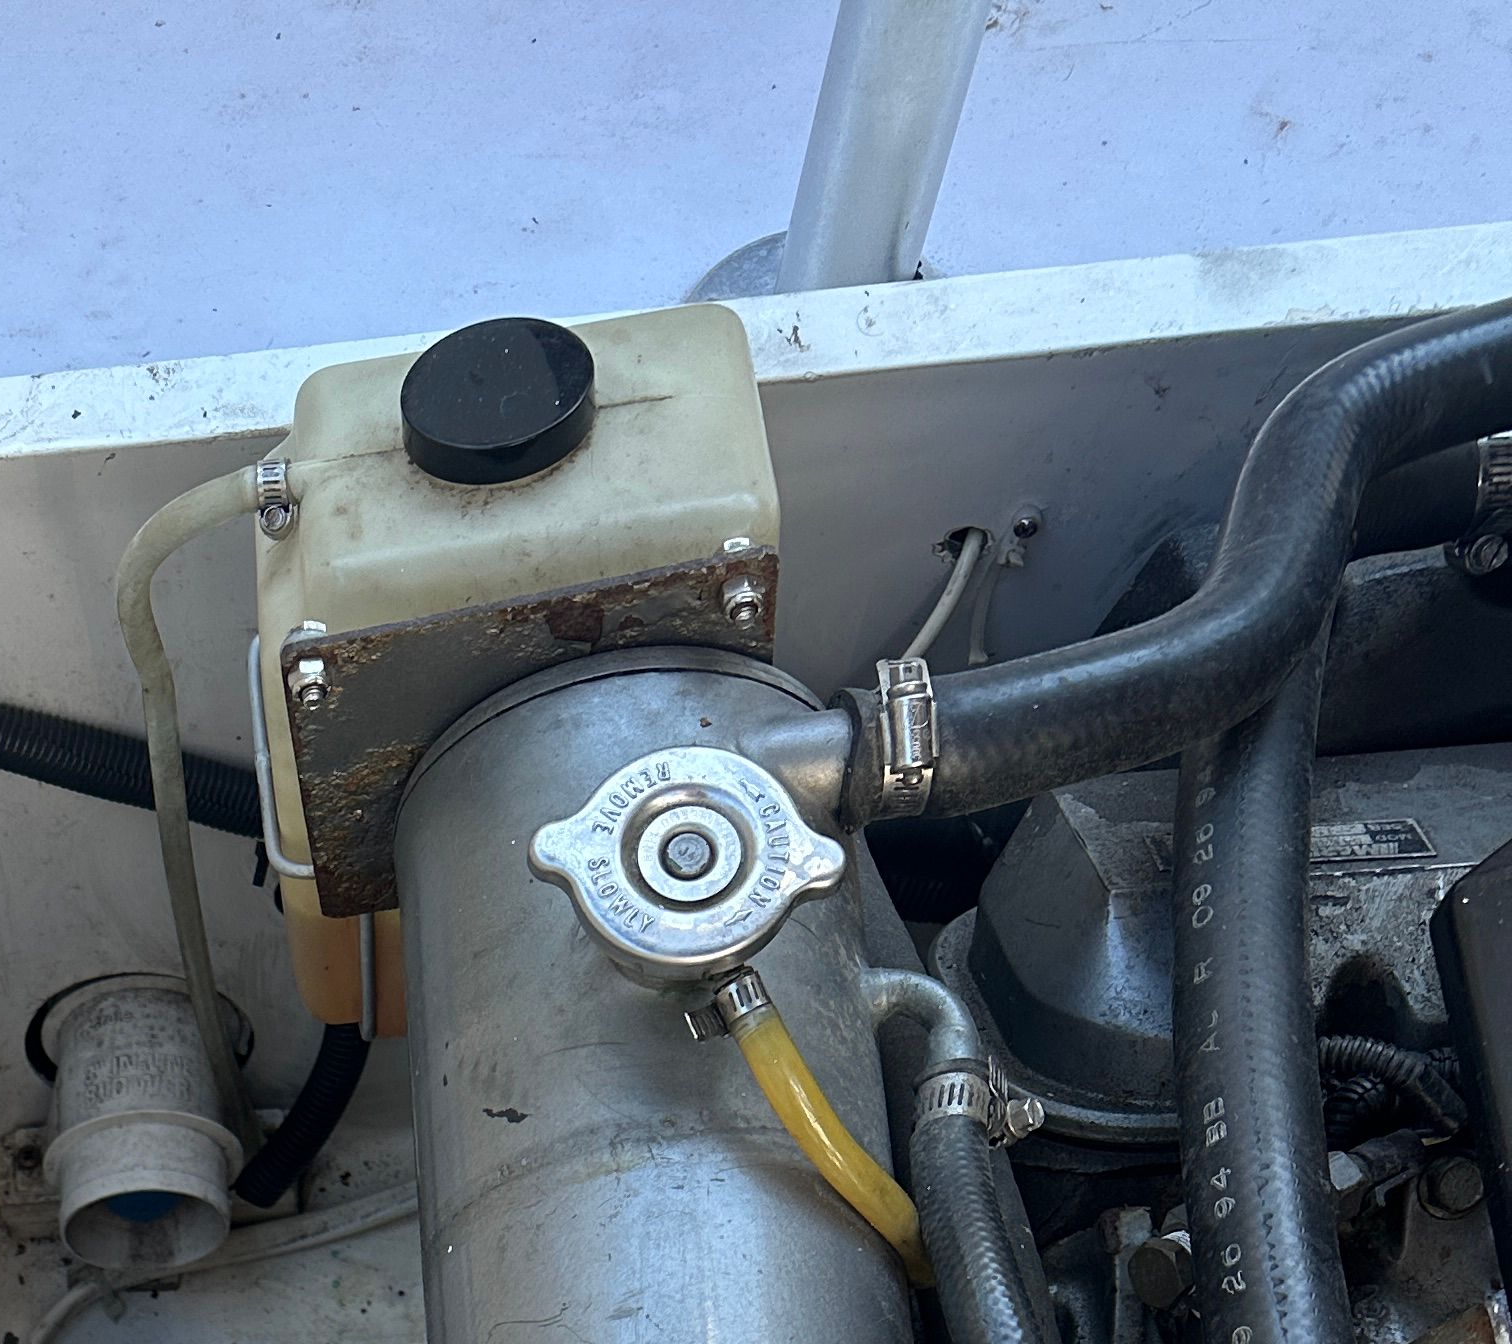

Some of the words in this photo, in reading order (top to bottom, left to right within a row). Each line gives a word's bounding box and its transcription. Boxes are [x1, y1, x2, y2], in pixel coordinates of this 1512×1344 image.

[591, 761, 671, 835] REMOVE
[748, 802, 790, 908] CAUTION
[587, 856, 655, 933] SLOWLY
[1192, 884, 1215, 928] 09
[1209, 1166, 1236, 1220] 94
